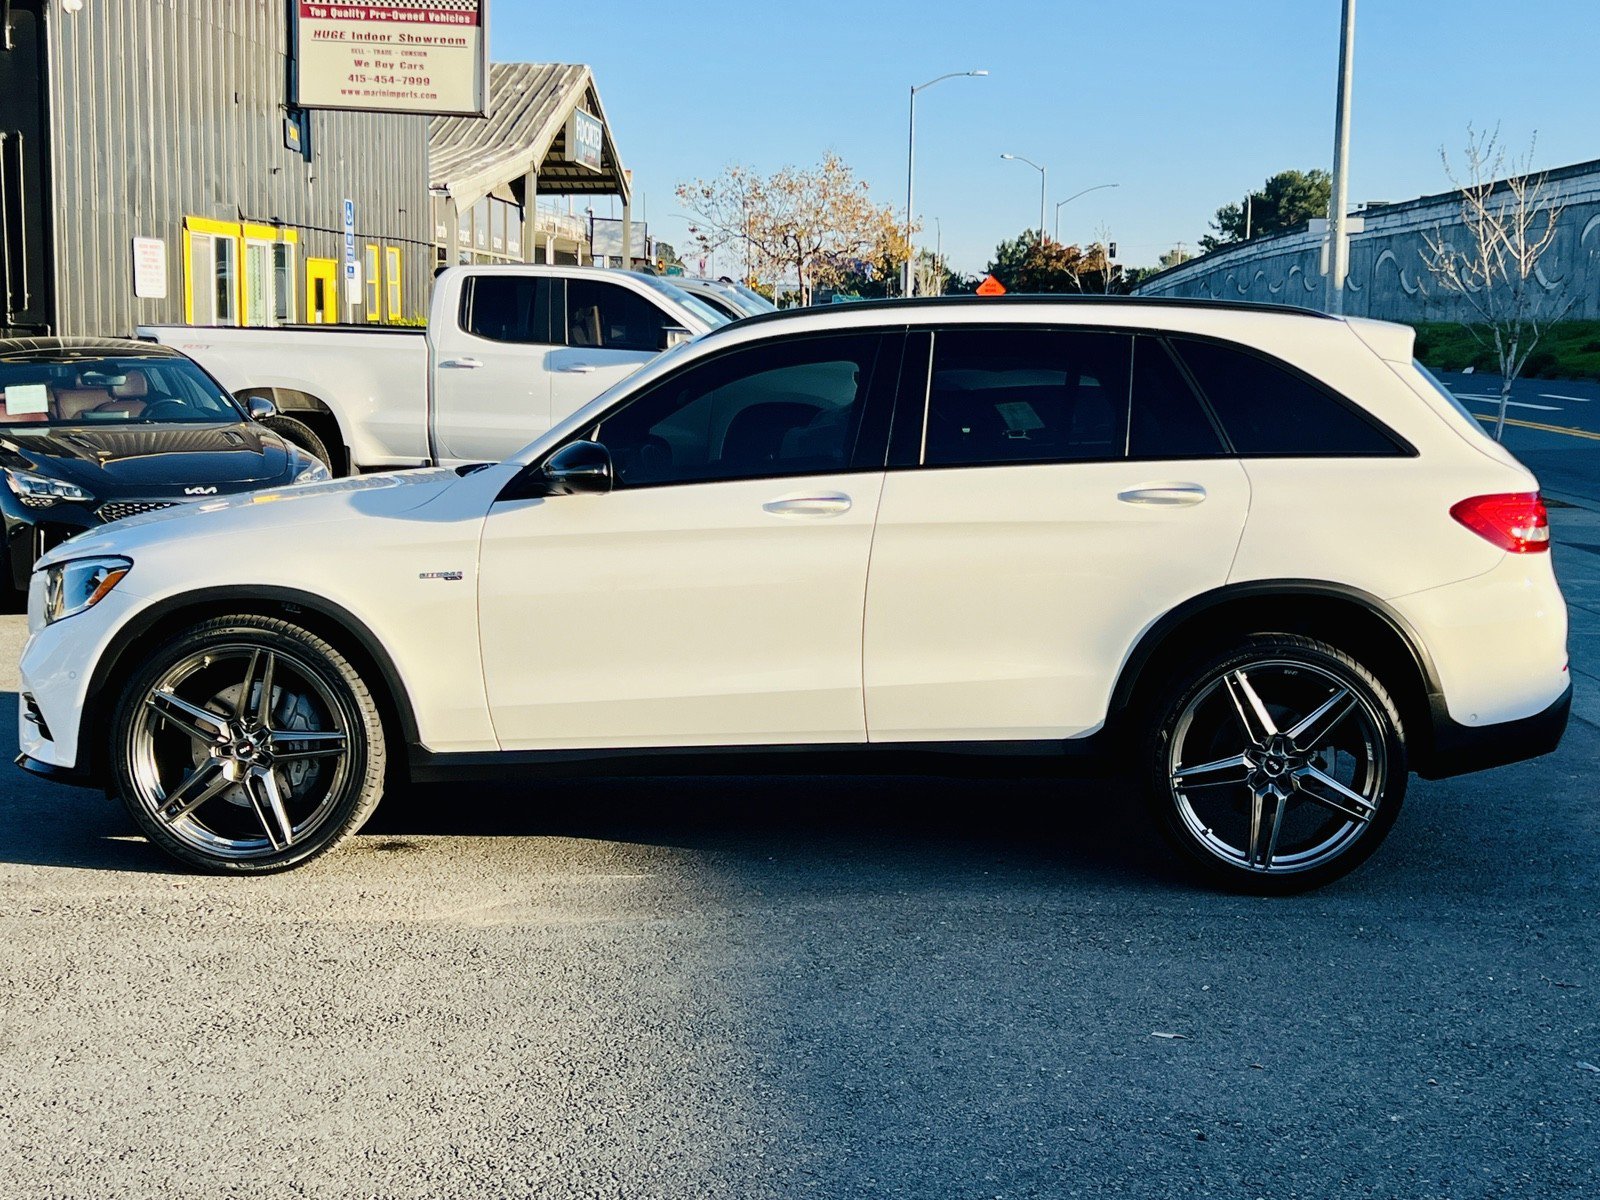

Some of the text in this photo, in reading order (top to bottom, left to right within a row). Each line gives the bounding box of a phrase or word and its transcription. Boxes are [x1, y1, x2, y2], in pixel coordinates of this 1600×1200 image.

[309, 6, 471, 24] Top Quality Pre-Owned Vehicles
[313, 30, 466, 45] HUGE Indoor Showroom
[354, 59, 425, 70] We Buy Cars
[348, 74, 431, 86] 415-454-7999
[340, 89, 438, 99] www.marinimports.com
